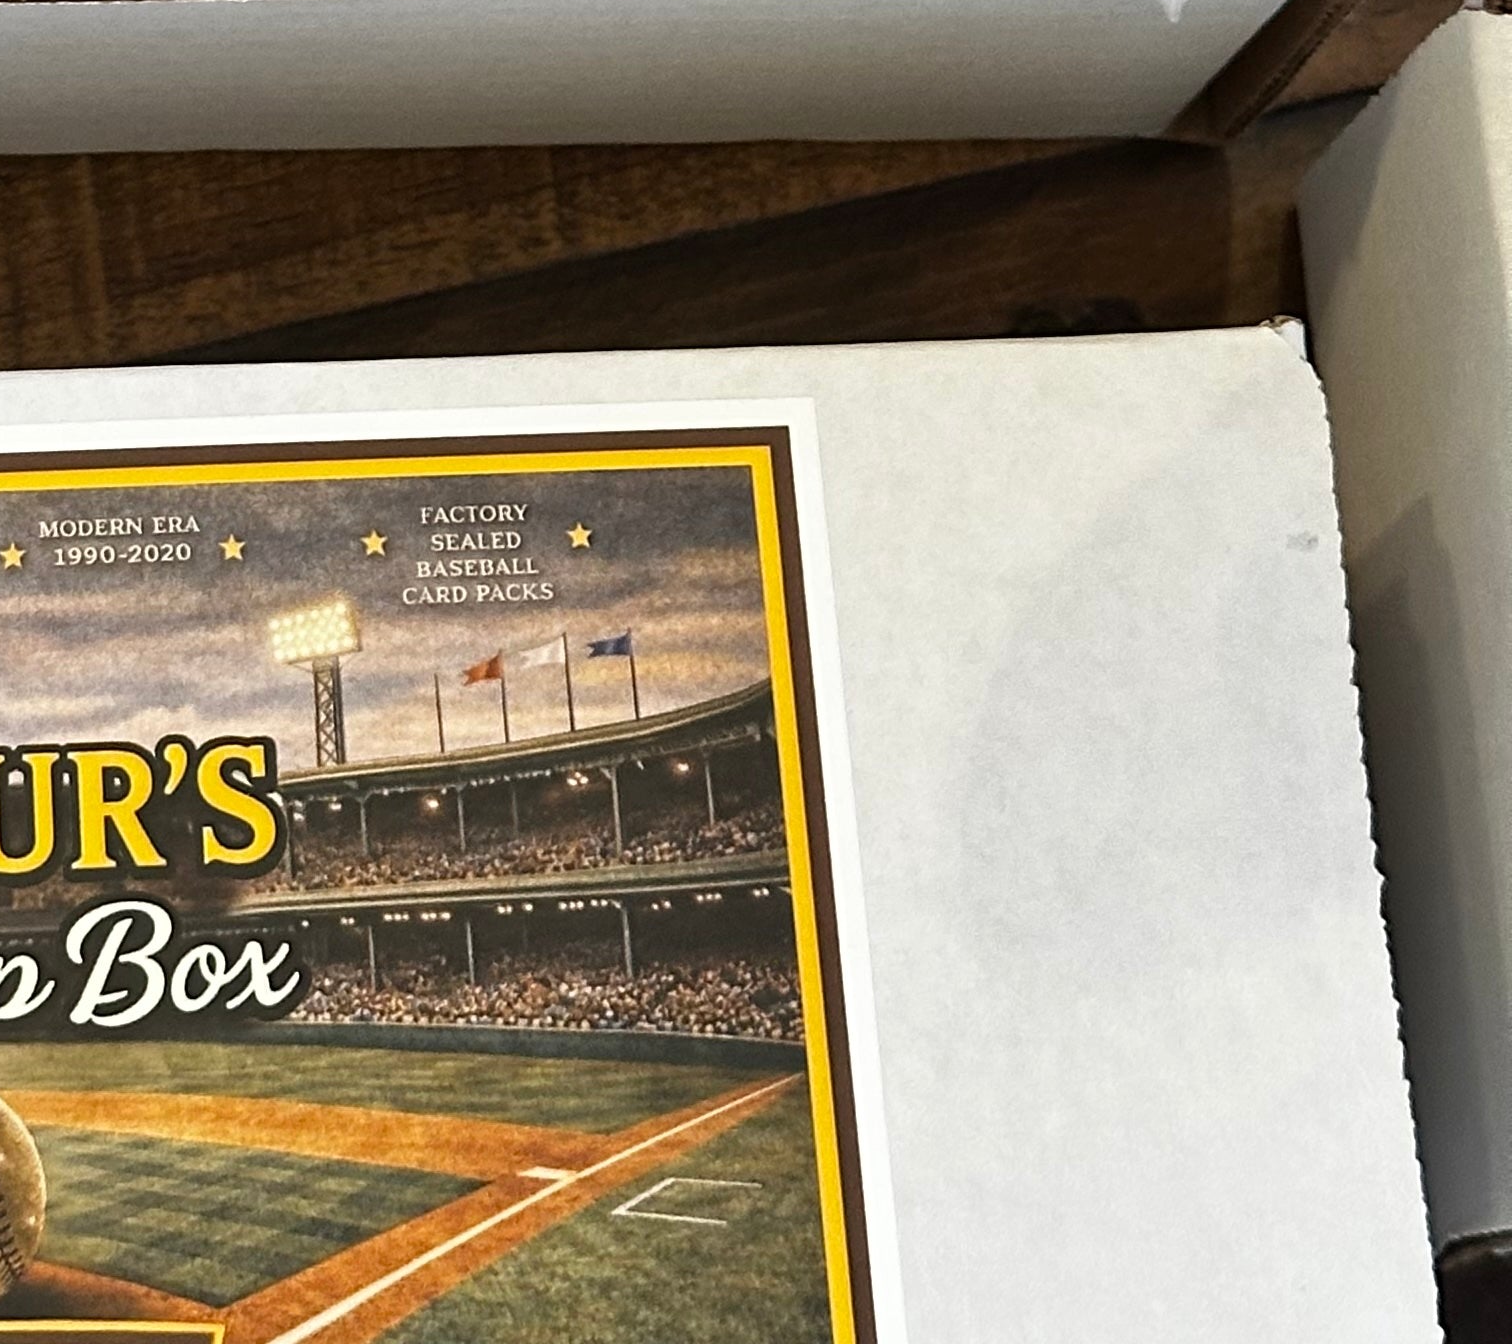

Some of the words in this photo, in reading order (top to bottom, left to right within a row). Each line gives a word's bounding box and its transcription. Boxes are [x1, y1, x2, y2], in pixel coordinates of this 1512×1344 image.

[37, 515, 145, 539] MODERN
[149, 513, 201, 535] ERA
[419, 502, 528, 526] FACTORY
[430, 528, 522, 553] SEALED
[52, 542, 193, 568] 1990-2020
[416, 556, 539, 579] BASEBALL
[401, 583, 470, 606] CARD
[476, 580, 555, 604] PACKS
[65, 899, 300, 1028] Box
